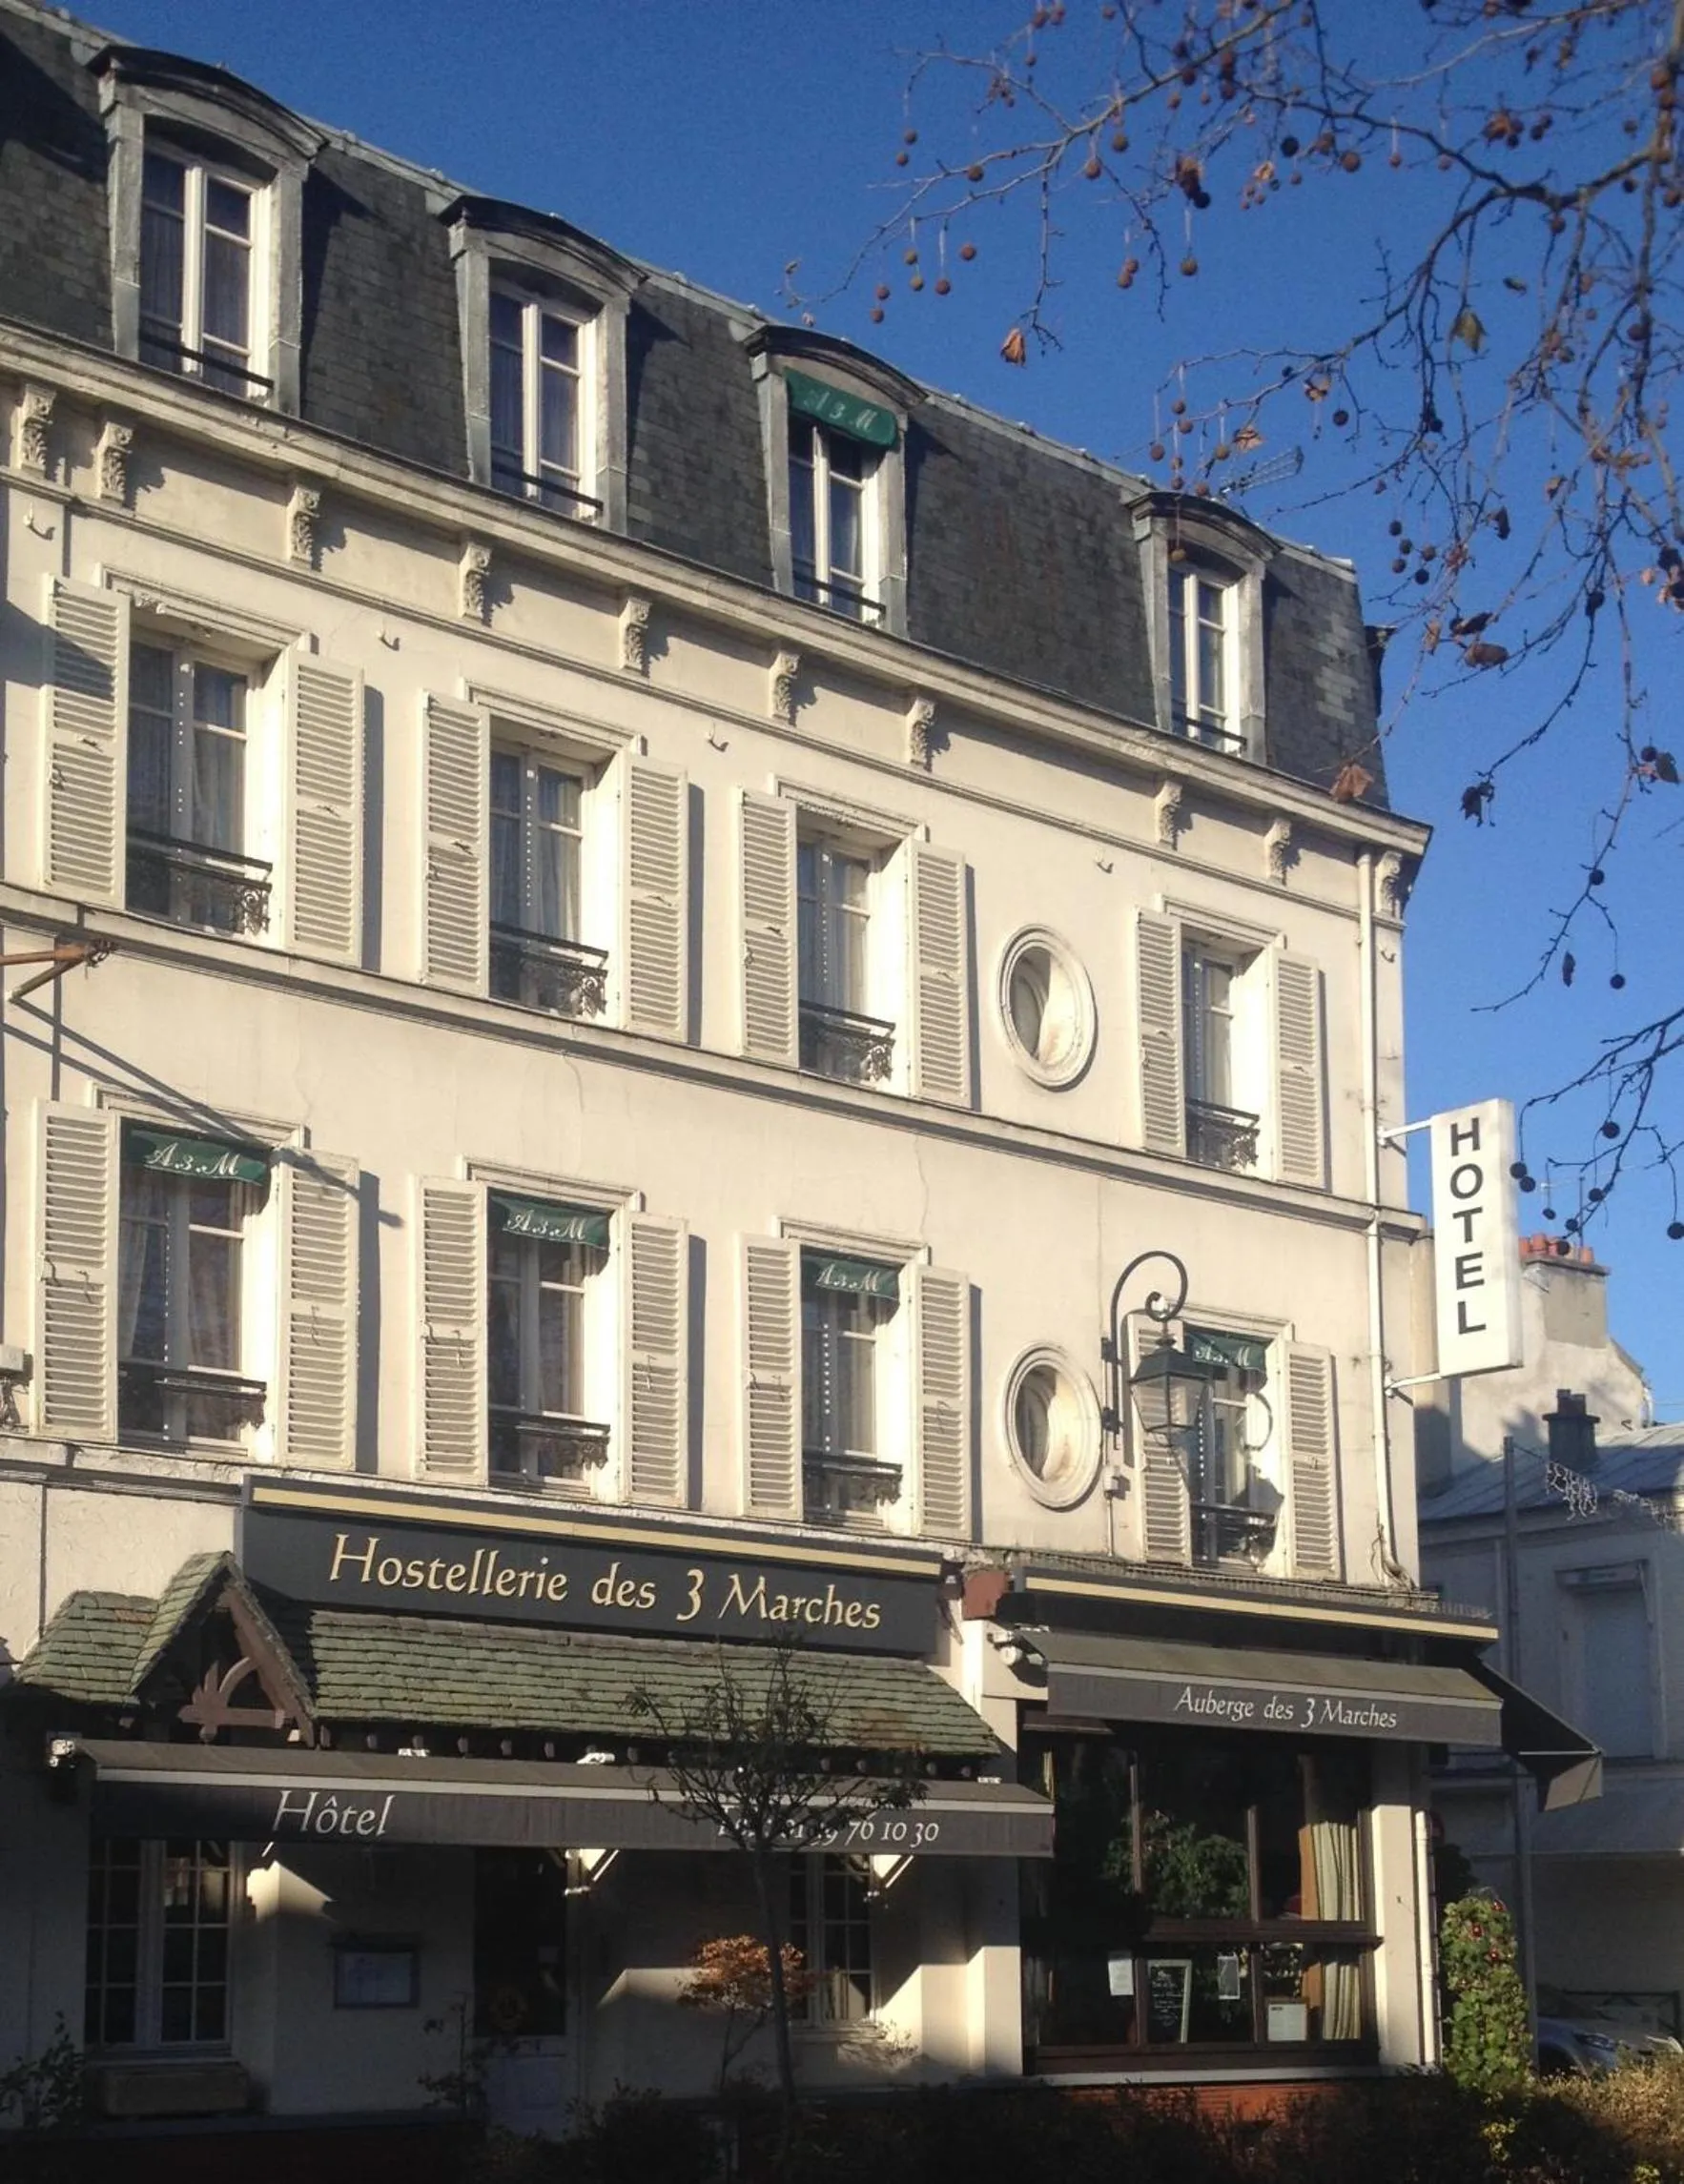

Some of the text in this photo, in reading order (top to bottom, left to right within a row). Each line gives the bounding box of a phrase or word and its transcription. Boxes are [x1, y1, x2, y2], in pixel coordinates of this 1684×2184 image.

[1450, 1117, 1487, 1335] HOTEL
[329, 1533, 882, 1629] Hostellerie des 3 Marches
[1174, 1685, 1398, 1729] Auberge des 3 Marches
[271, 1789, 397, 1837] Hôtel
[844, 1811, 877, 1846] 76
[880, 1822, 907, 1841] 10
[909, 1822, 940, 1848] 30
